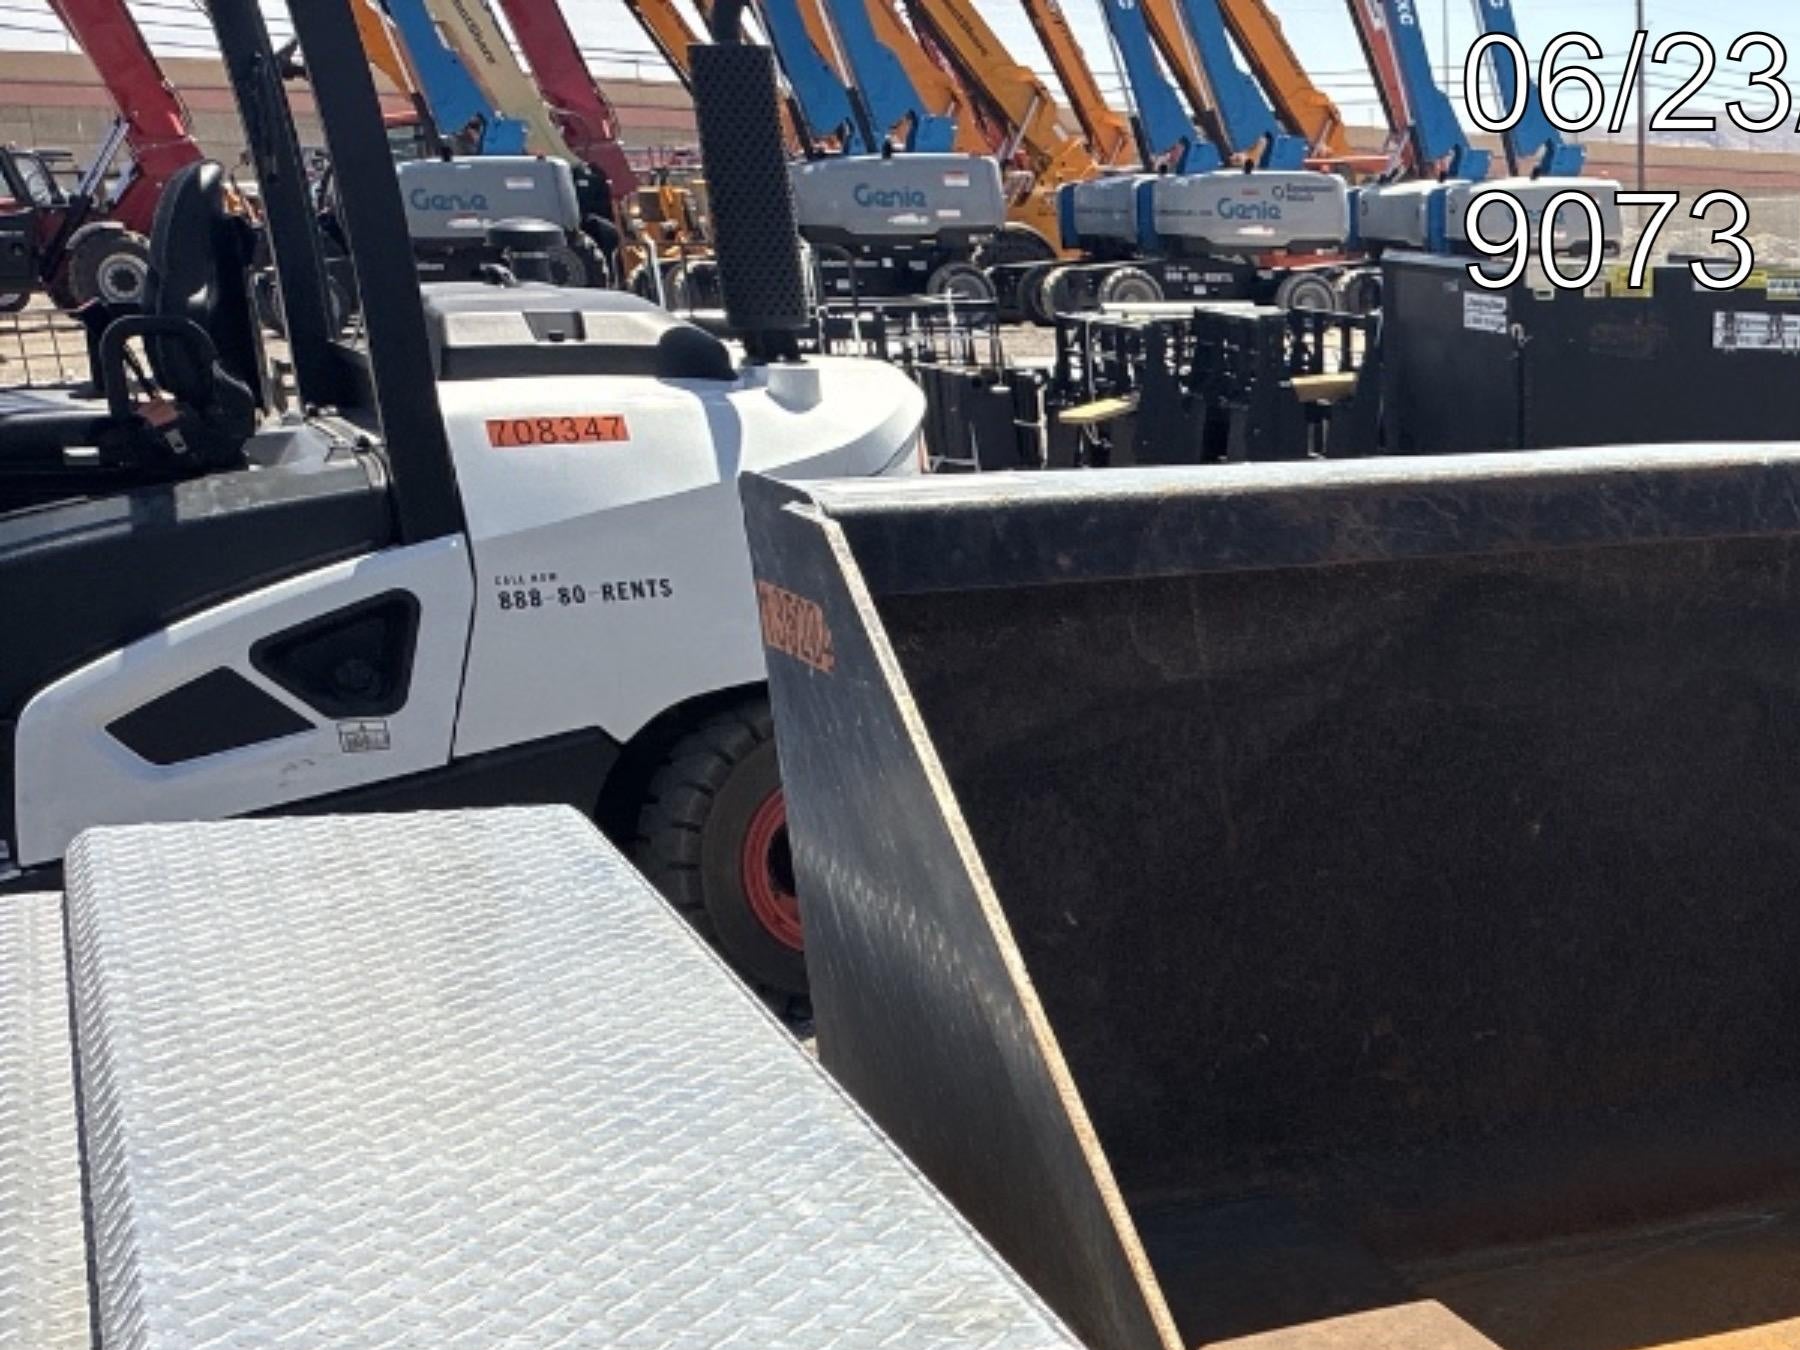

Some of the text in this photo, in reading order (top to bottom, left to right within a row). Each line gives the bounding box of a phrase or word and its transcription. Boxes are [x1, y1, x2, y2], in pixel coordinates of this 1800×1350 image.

[853, 182, 928, 208] Genie
[1216, 197, 1282, 220] Genie
[489, 415, 623, 447] 708347
